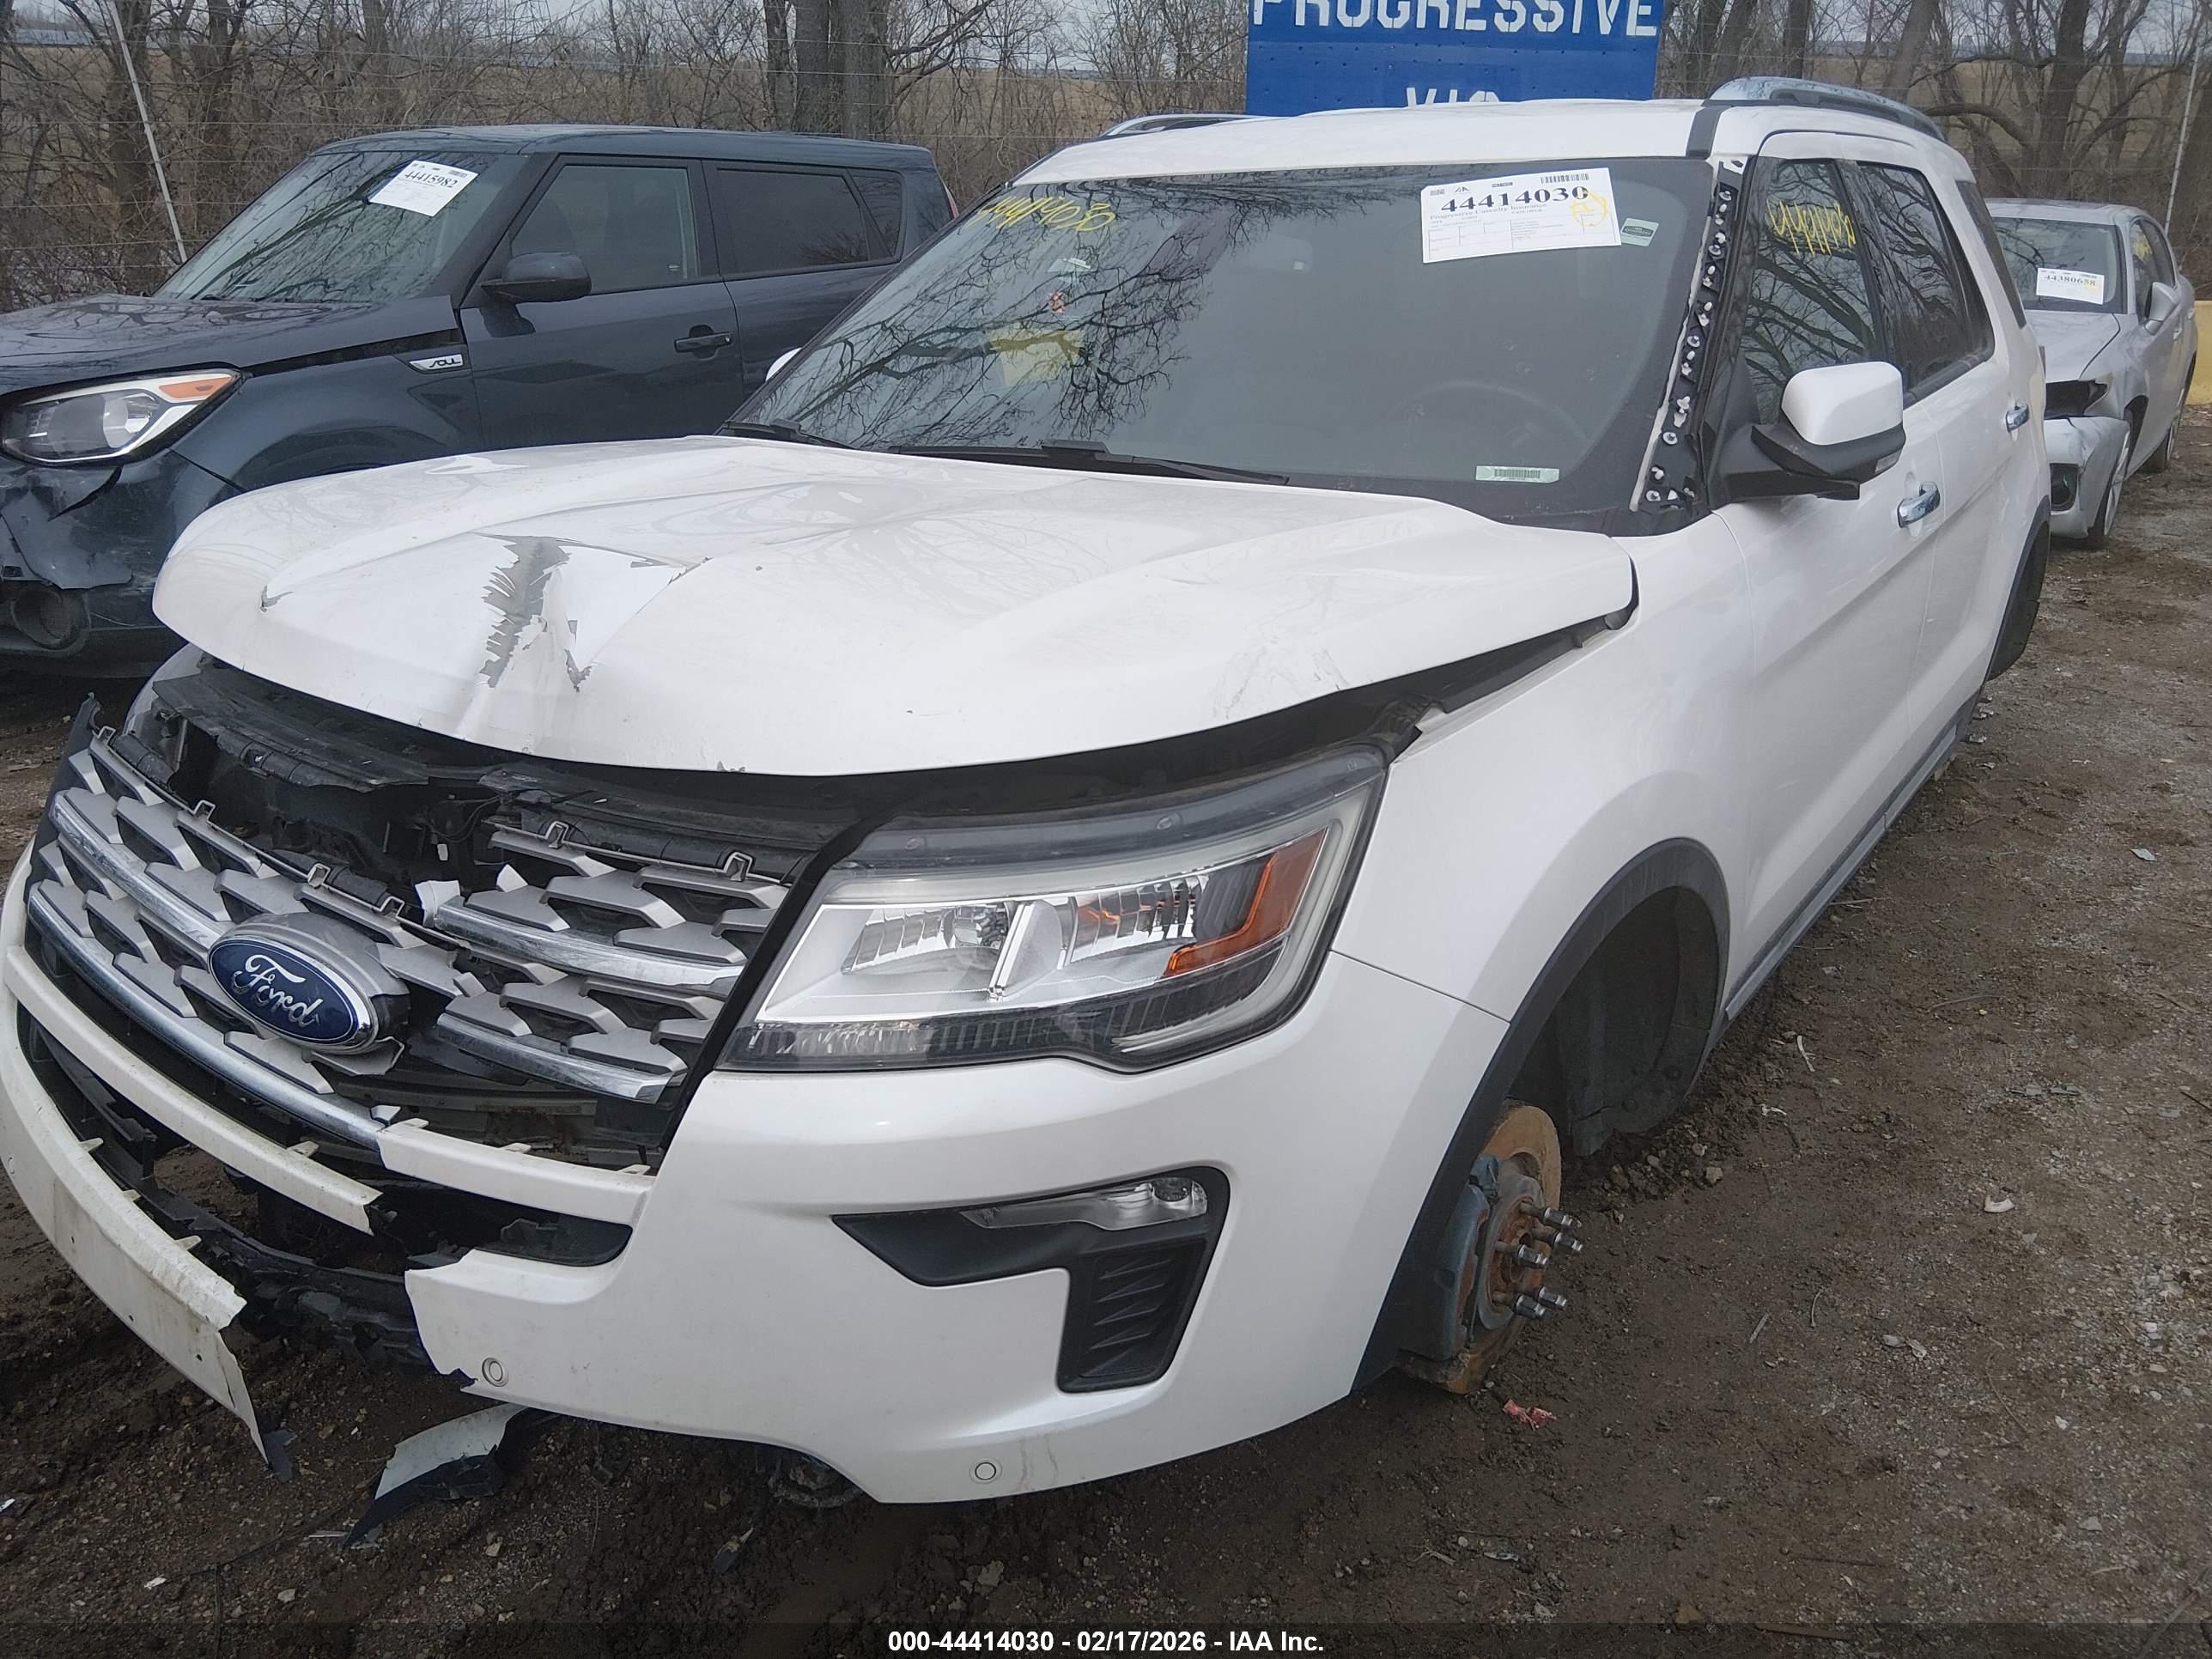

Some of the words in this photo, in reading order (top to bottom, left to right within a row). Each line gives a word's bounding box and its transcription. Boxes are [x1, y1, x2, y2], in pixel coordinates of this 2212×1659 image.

[1253, 0, 1656, 37] PROGRESSIVE
[404, 171, 459, 188] 44415982
[1441, 185, 1589, 213] 44414030
[232, 954, 323, 1028] Ford
